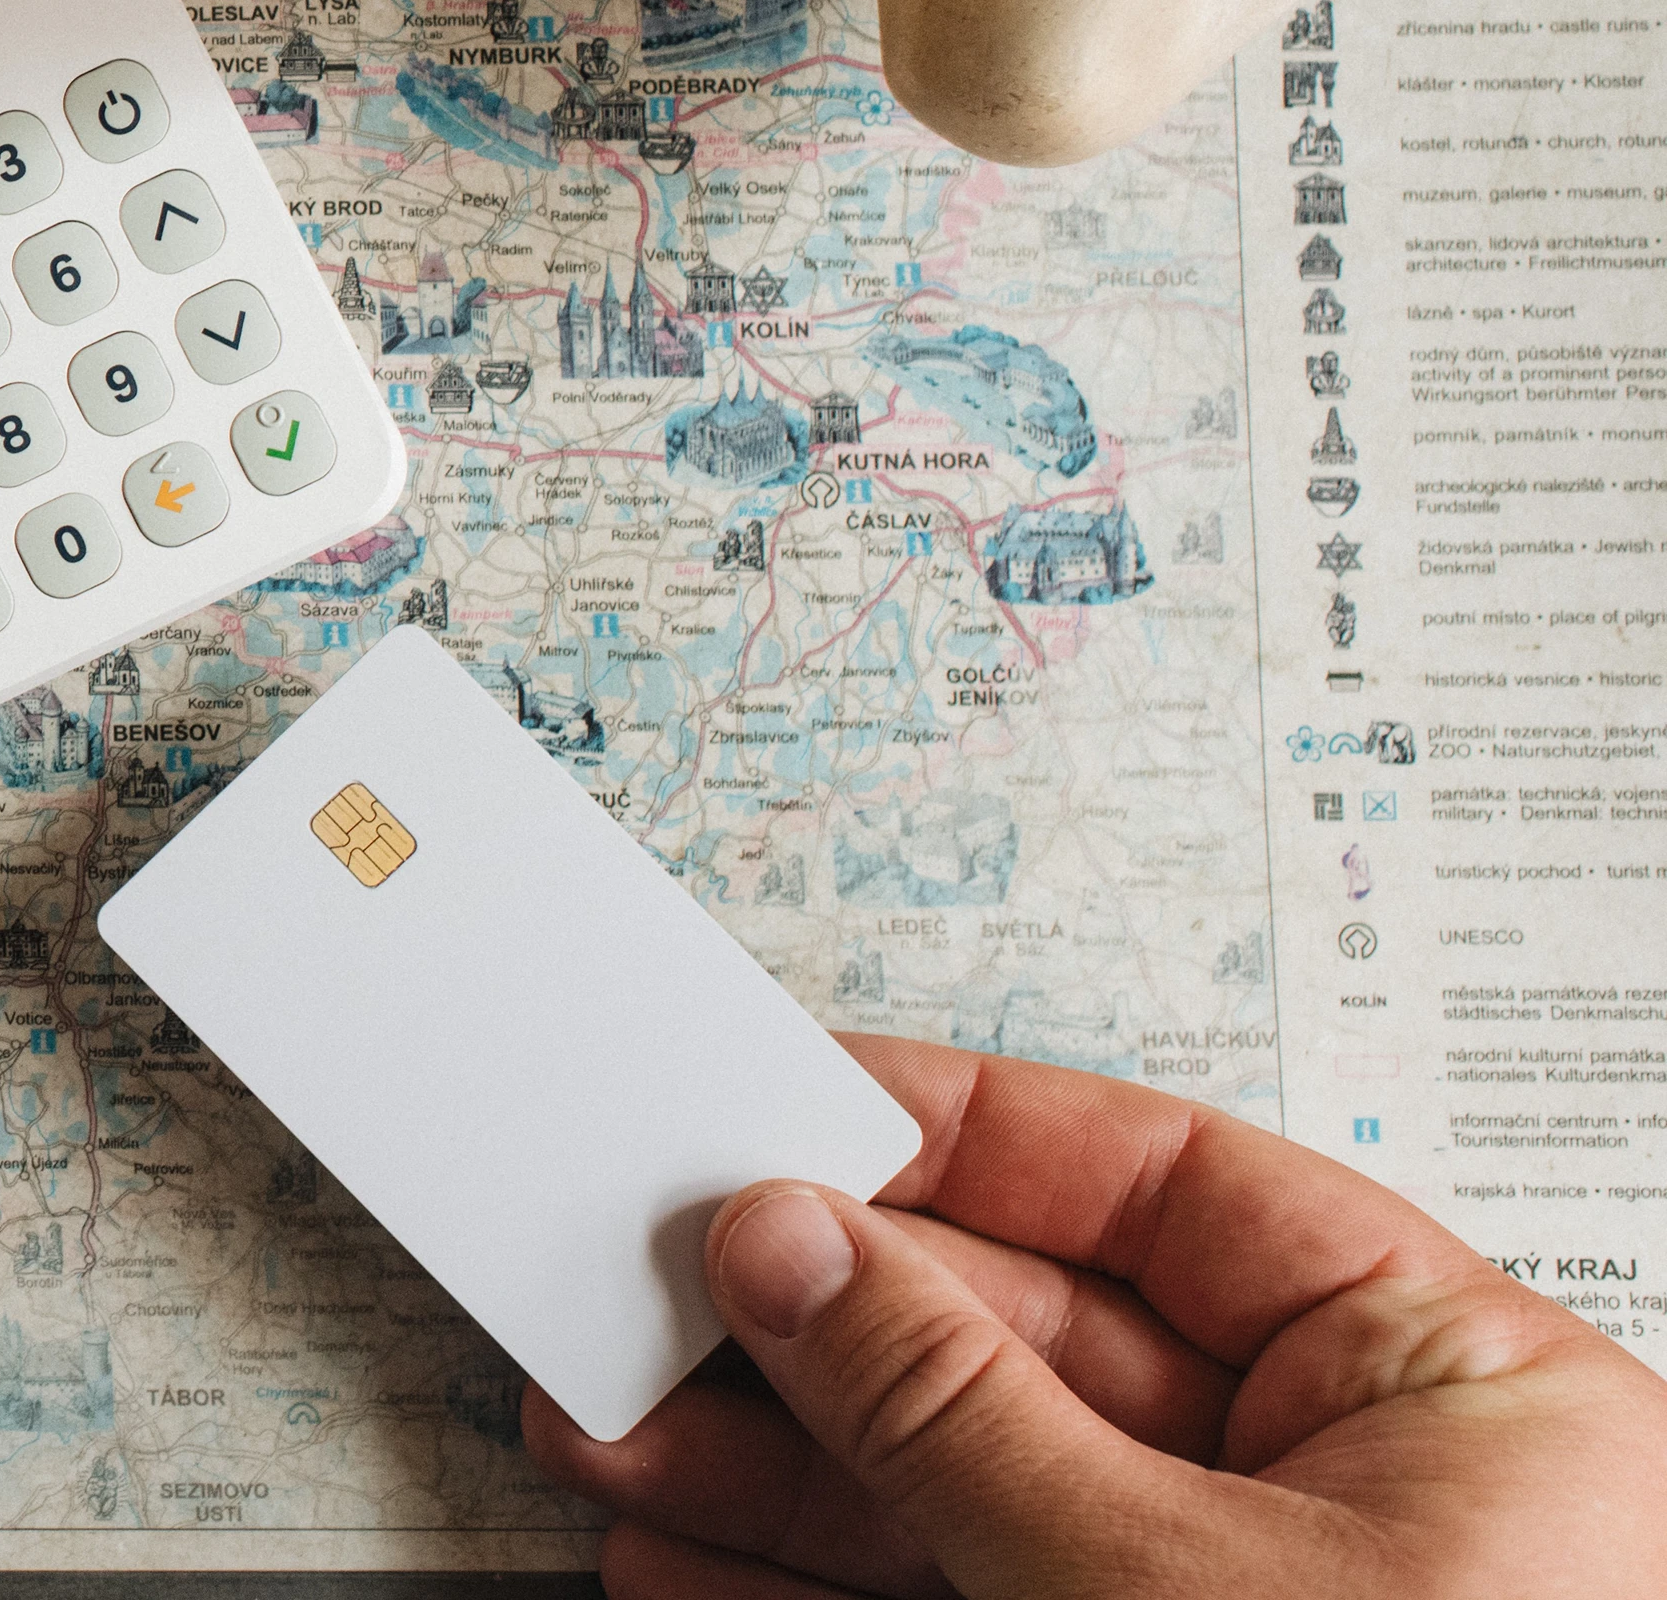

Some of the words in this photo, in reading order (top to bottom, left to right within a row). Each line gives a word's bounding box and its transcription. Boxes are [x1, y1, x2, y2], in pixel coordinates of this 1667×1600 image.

[1480, 20, 1531, 35] hradu
[1549, 18, 1600, 34] castle
[1606, 19, 1650, 33] ruins
[450, 47, 561, 66] NYMBURK
[629, 75, 760, 96] PODĚBRADY
[1397, 76, 1455, 92] klášter
[1473, 75, 1565, 94] monastery
[1583, 74, 1645, 89] Kloster
[463, 192, 509, 209] Pečky
[49, 253, 82, 293] 6
[1406, 305, 1454, 321] lázně
[1472, 307, 1504, 324] spa
[1522, 304, 1576, 319] Kurort
[740, 318, 810, 339] KOLÍN
[105, 364, 138, 403] 9
[1410, 367, 1472, 386] activity
[1478, 366, 1496, 382] of
[1501, 369, 1513, 382] a
[1519, 365, 1610, 384] prominent
[838, 451, 915, 471] KUTNÁ
[924, 449, 989, 470] HORA
[846, 509, 931, 530] ČÁSLAV
[54, 525, 87, 564] 0
[1418, 540, 1494, 556] židovská
[1499, 539, 1575, 557] památka
[1595, 538, 1654, 554] Jewish
[569, 577, 634, 592] Uhlířské
[569, 597, 639, 613] Janovice
[1422, 611, 1477, 628] poutní
[1482, 610, 1531, 626] místo
[1549, 610, 1596, 628] place
[1602, 609, 1619, 625] of
[1424, 672, 1508, 688] historická
[1514, 674, 1581, 687] vesnice
[1598, 671, 1662, 687] historic
[946, 687, 1039, 707] JENÍKOV
[112, 721, 220, 743] BENEŠOV
[710, 729, 799, 745] Zbraslavice
[1434, 864, 1511, 883] turistický
[1517, 864, 1582, 882] pochod
[1606, 864, 1651, 880] turist
[1439, 928, 1525, 946] UNESCO
[1340, 995, 1387, 1008] KOLÍN
[1142, 1028, 1276, 1049] HAVLÍČKŮV
[1445, 1048, 1513, 1063] národní
[1518, 1047, 1583, 1064] kulturní
[1589, 1048, 1666, 1066] památka
[1144, 1058, 1211, 1075] BROD
[1449, 1112, 1541, 1129] informační
[1546, 1114, 1619, 1129] centrum
[1451, 1131, 1629, 1149] Touristeninformation
[1453, 1183, 1517, 1202] krajská
[1522, 1183, 1588, 1199] hranice
[1556, 1258, 1637, 1281] KRAJ
[147, 1386, 225, 1407] TÁBOR
[161, 1481, 269, 1501] SEZIMOVO
[195, 1503, 243, 1523] ÚSTÍ
